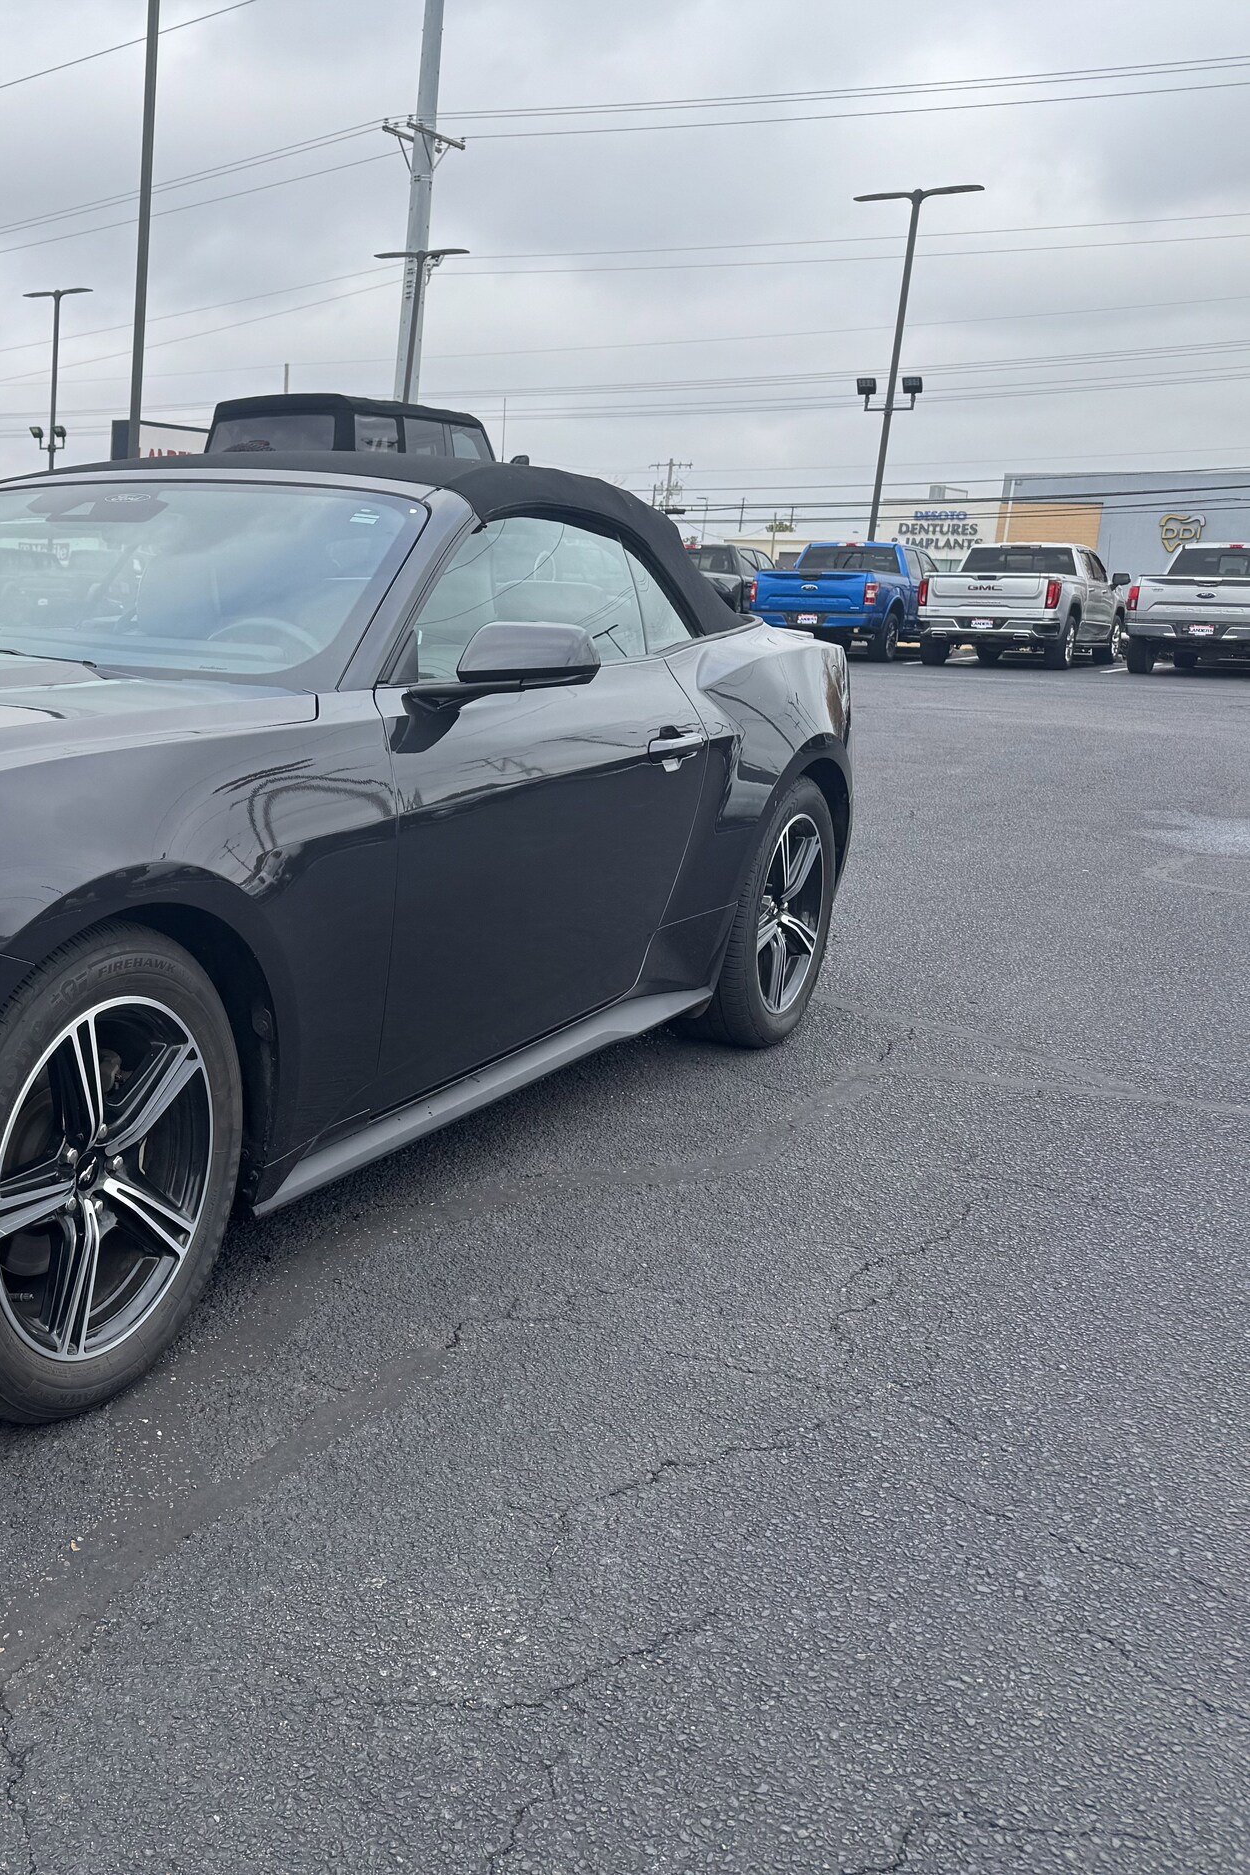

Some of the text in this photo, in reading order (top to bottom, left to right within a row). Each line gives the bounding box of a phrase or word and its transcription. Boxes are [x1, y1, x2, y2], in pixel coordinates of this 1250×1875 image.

[913, 510, 967, 520] DESOTO
[898, 522, 979, 536] DENTURES
[1161, 526, 1202, 540] DDI
[97, 957, 176, 979] FIREHAWK
